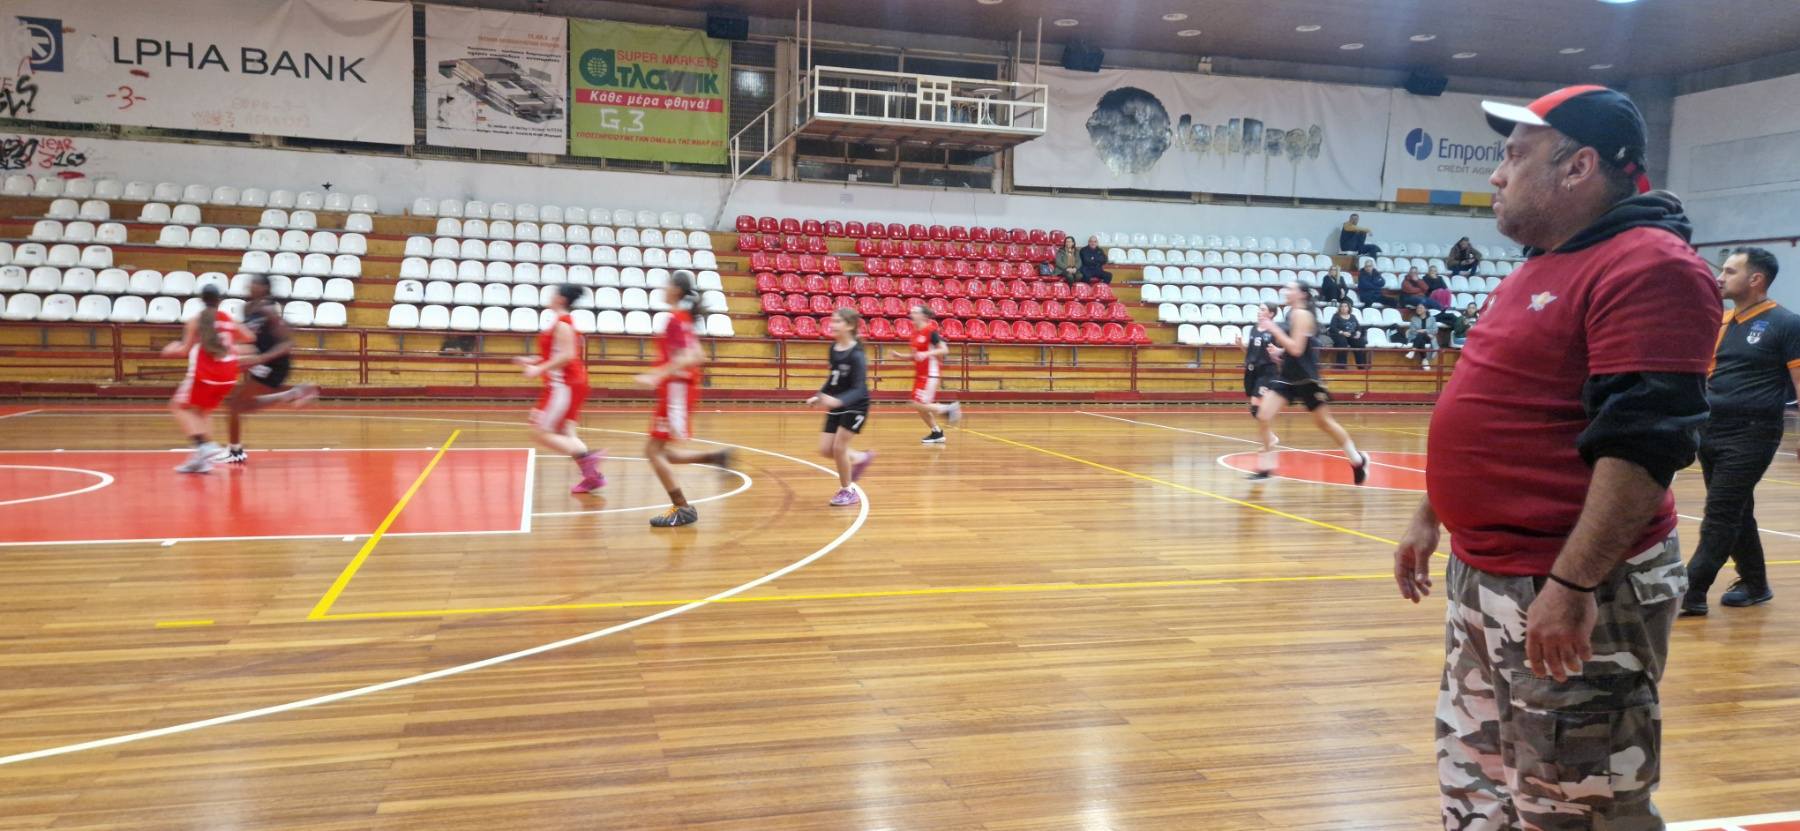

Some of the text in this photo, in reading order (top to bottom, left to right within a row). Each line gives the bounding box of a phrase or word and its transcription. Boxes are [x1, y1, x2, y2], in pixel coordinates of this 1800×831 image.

[113, 36, 367, 83] LPHA BANK
[616, 50, 719, 69] SUPER MARKETS
[590, 89, 710, 110] Κάθε μέρα φθηνά!
[1438, 138, 1505, 165] Emporik
[1437, 165, 1496, 176] CREDIT AGR
[851, 414, 865, 430] 7
